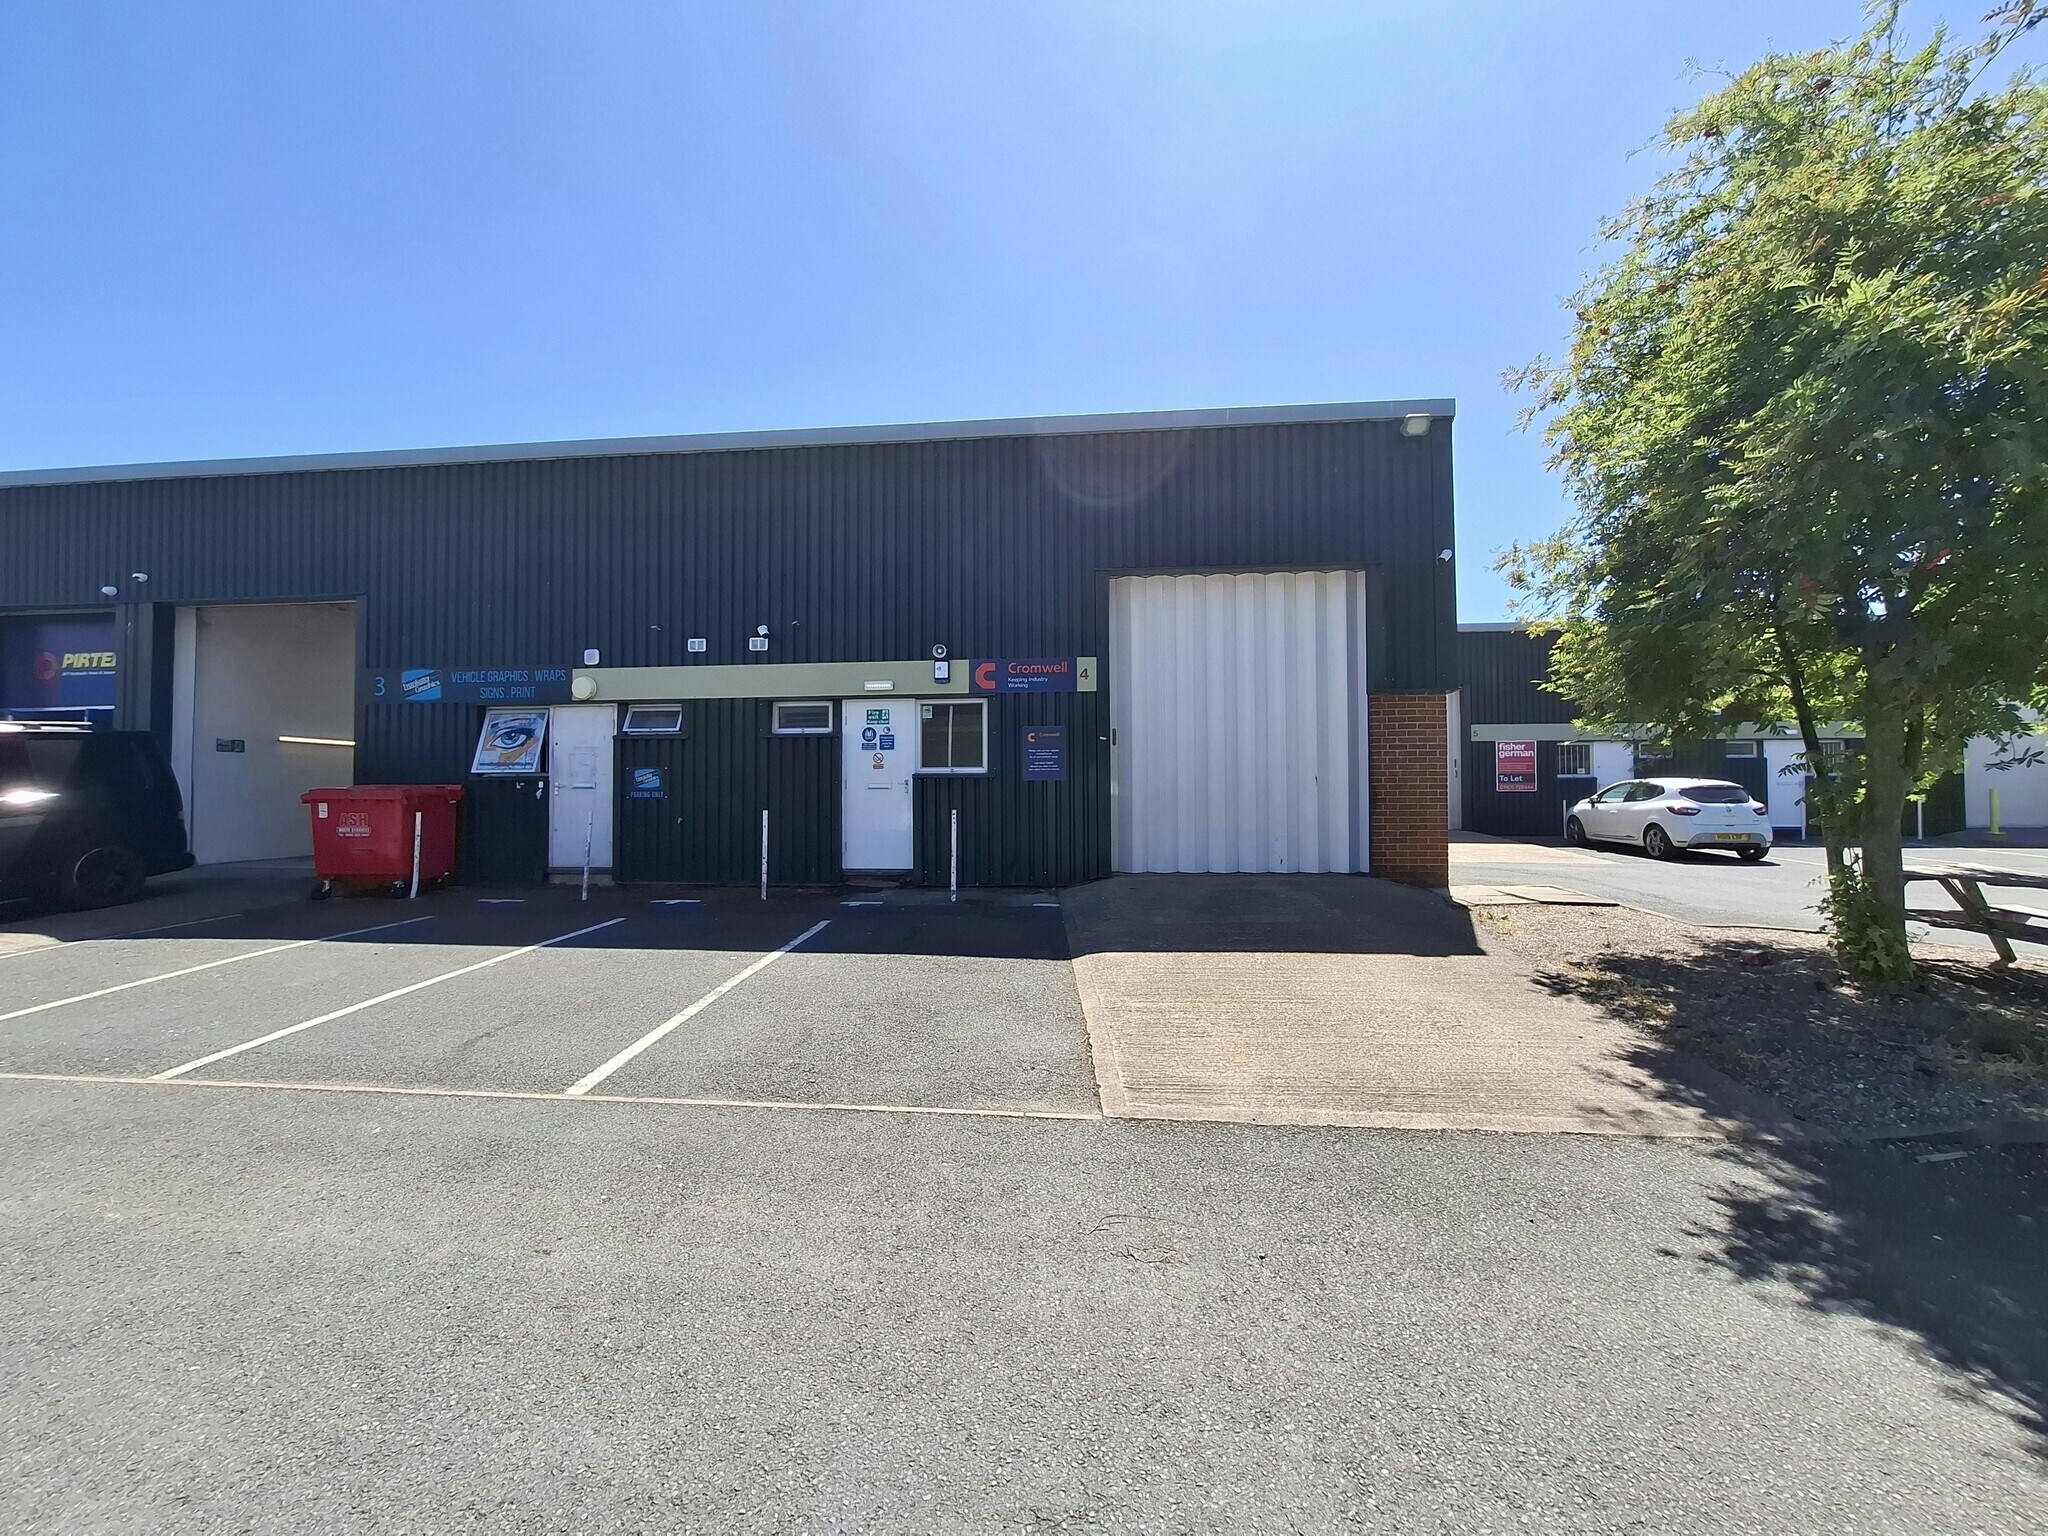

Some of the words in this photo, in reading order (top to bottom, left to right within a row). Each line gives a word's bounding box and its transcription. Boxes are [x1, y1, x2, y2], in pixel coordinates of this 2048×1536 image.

[61, 652, 117, 669] PIRTE
[1008, 661, 1068, 674] Cromwell
[1079, 668, 1090, 680] 4
[451, 671, 486, 683] VEHICLE
[487, 670, 529, 682] GRAPHICS
[535, 669, 567, 681] WRAPS
[374, 676, 386, 696] 3
[480, 687, 505, 699] SIGNS
[511, 686, 536, 698] PRINT
[1498, 750, 1534, 758] german
[340, 812, 369, 826] ASH
